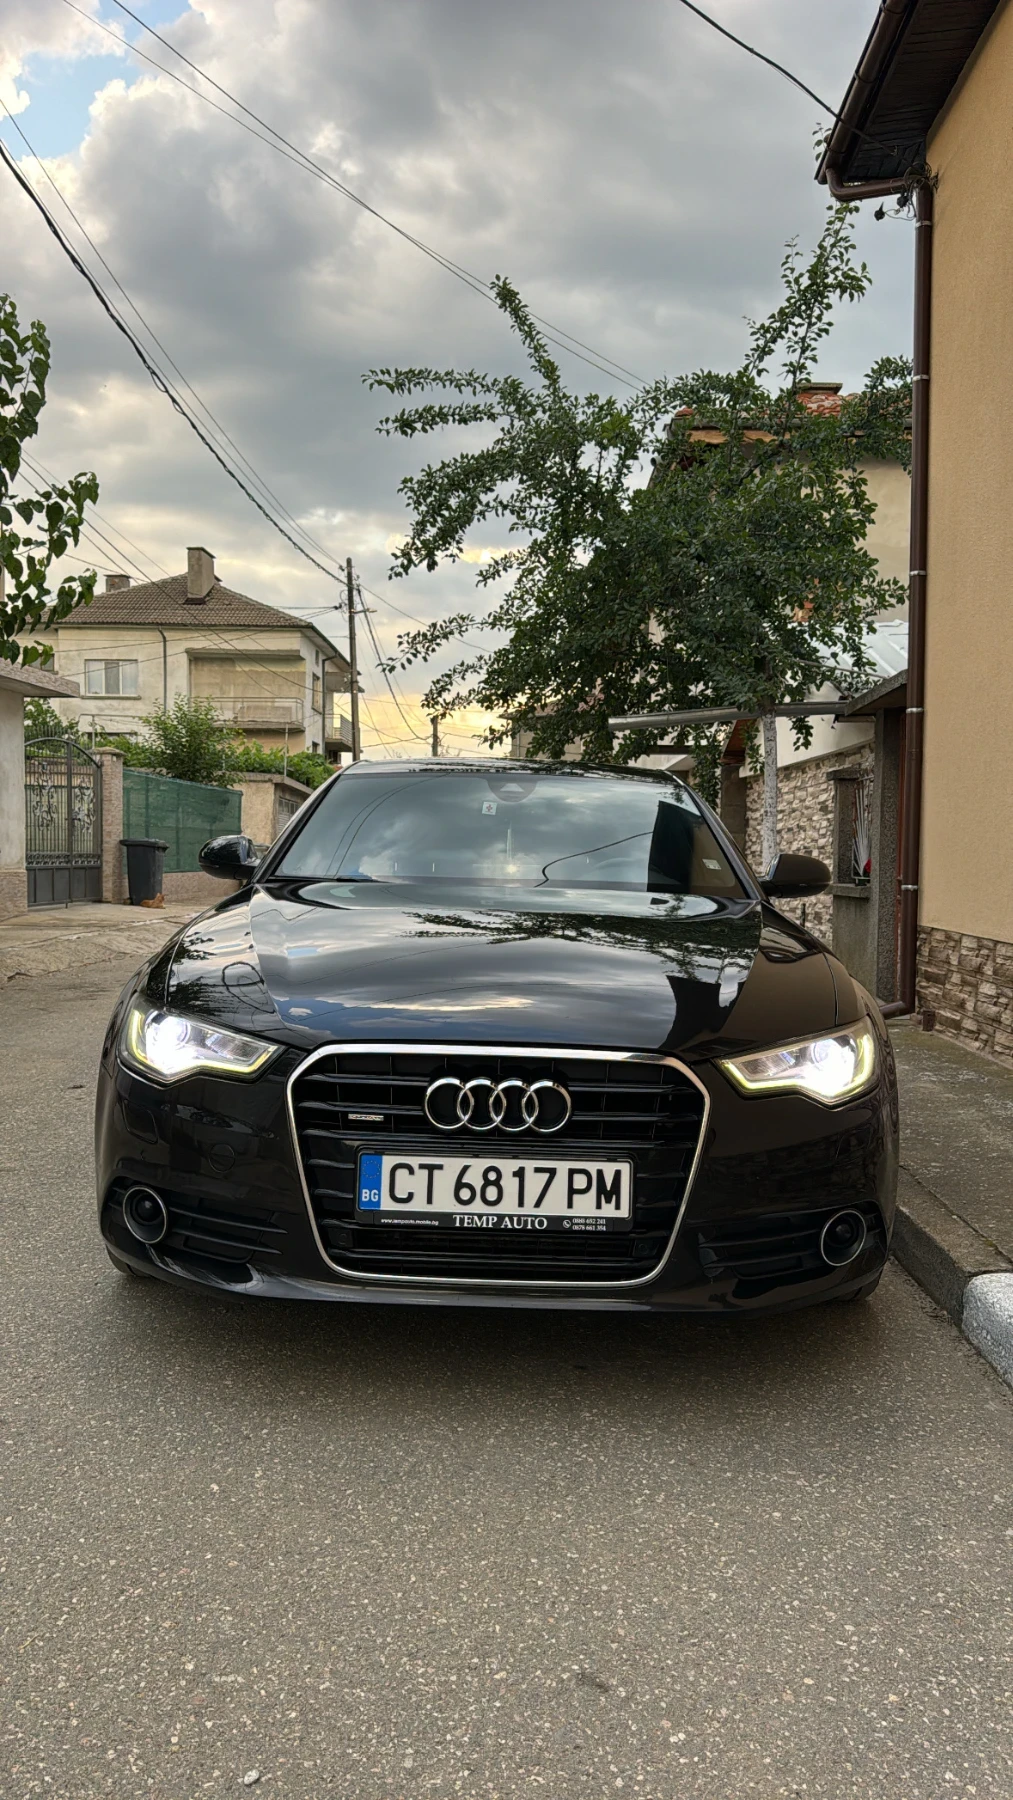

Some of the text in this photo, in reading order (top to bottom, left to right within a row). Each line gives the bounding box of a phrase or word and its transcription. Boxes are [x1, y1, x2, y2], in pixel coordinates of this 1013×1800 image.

[389, 1162, 622, 1211] CT 6817 PM
[361, 1189, 379, 1202] BG
[452, 1214, 548, 1230] TEMP AUTO
